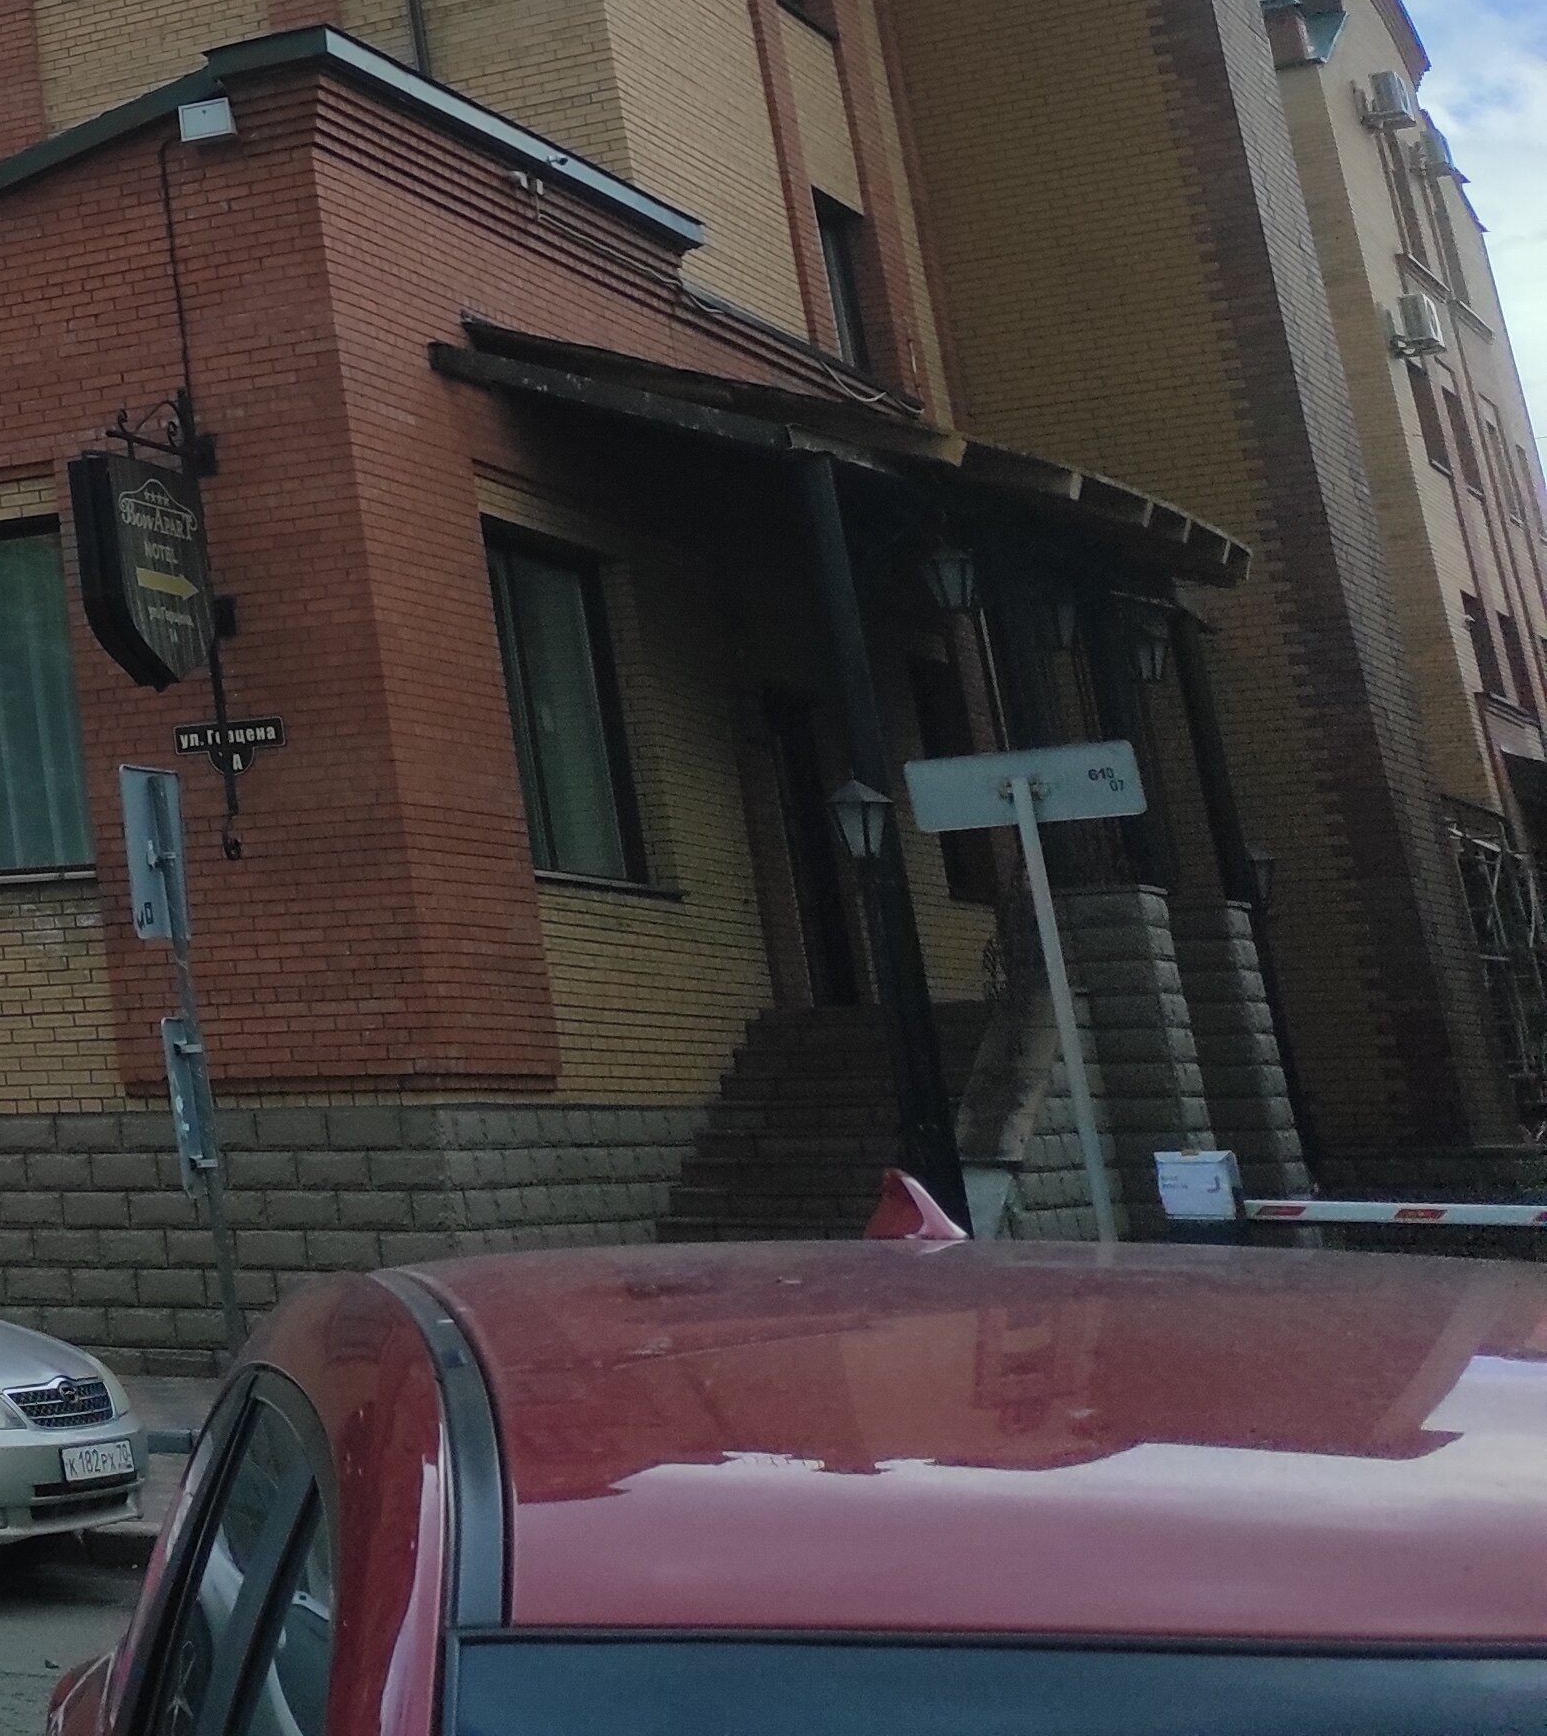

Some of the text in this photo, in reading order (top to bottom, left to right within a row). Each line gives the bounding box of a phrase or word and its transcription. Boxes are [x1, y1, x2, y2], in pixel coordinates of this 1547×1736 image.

[179, 732, 205, 750] ул.
[1087, 767, 1115, 781] 610
[1109, 779, 1124, 792] 07
